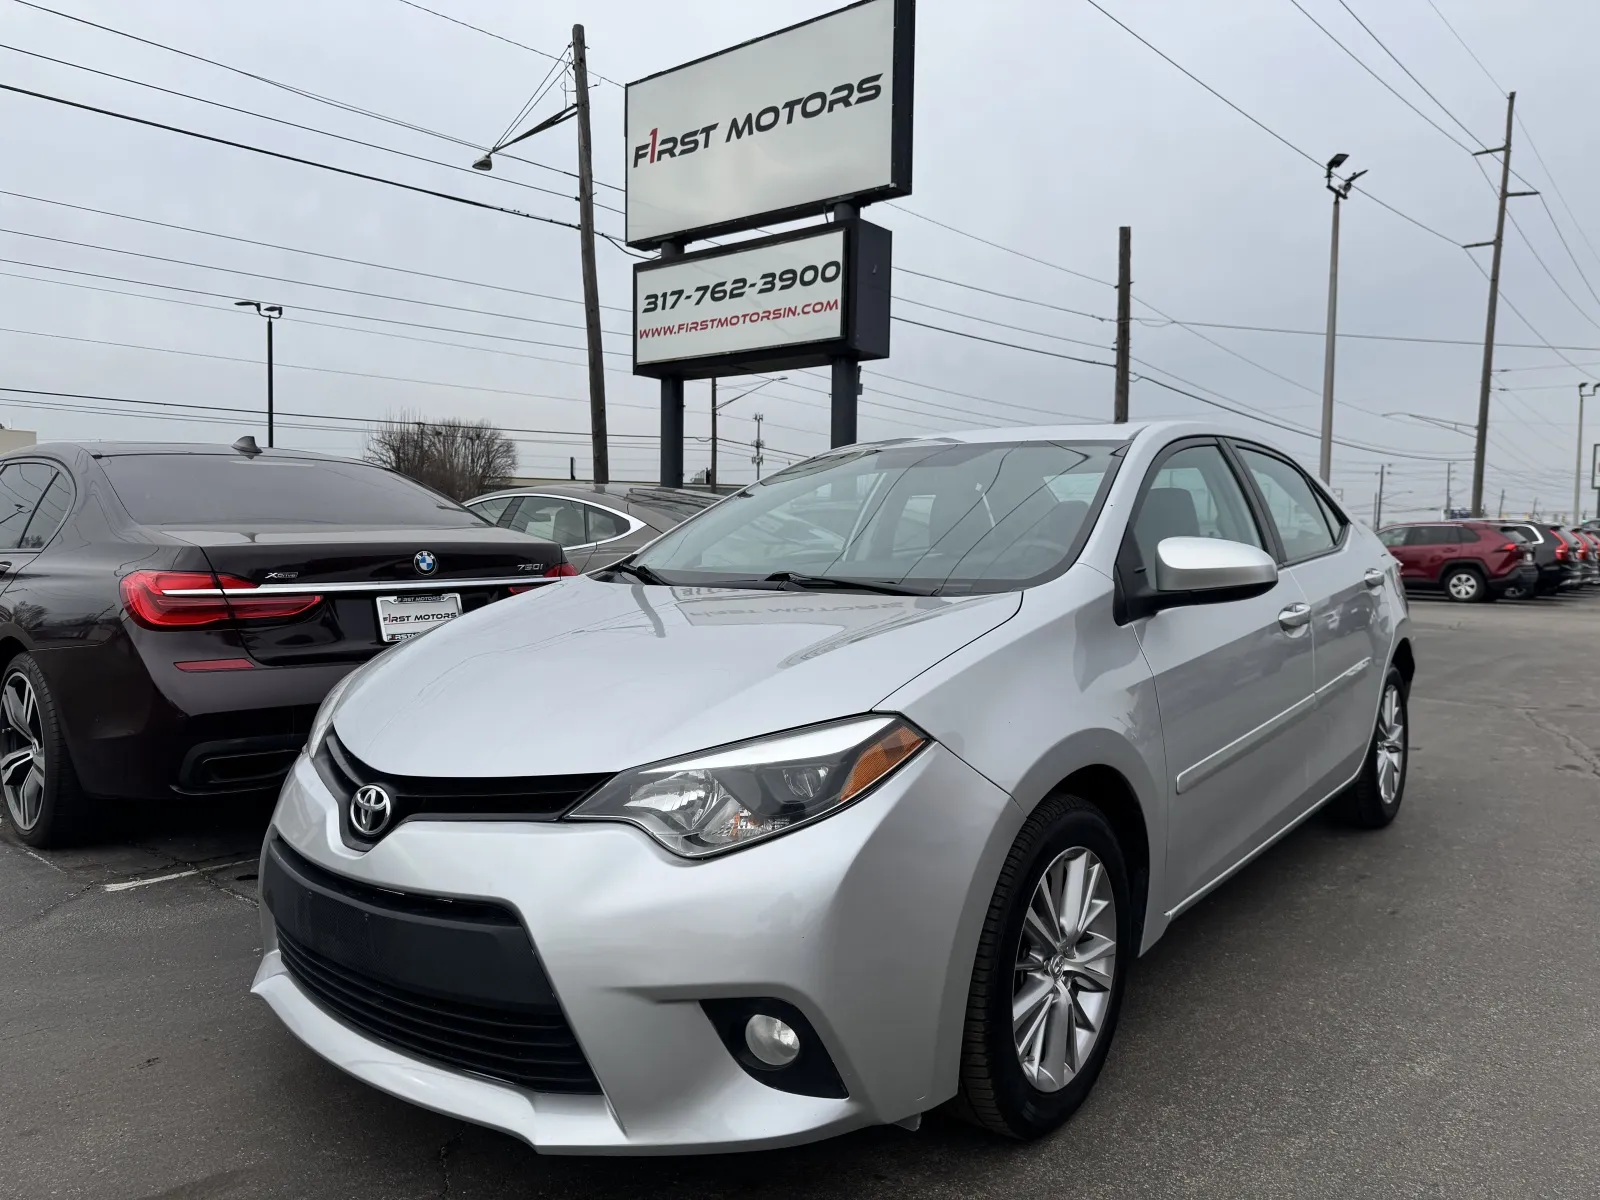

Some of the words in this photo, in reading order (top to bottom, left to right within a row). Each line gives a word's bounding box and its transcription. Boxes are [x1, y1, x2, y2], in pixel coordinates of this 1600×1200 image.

[725, 73, 884, 143] MOTORS
[642, 260, 841, 313] 317-762-3900
[639, 299, 839, 339] WWW.FIRSTMOTORSIN.COM
[414, 612, 457, 621] MOTORS
